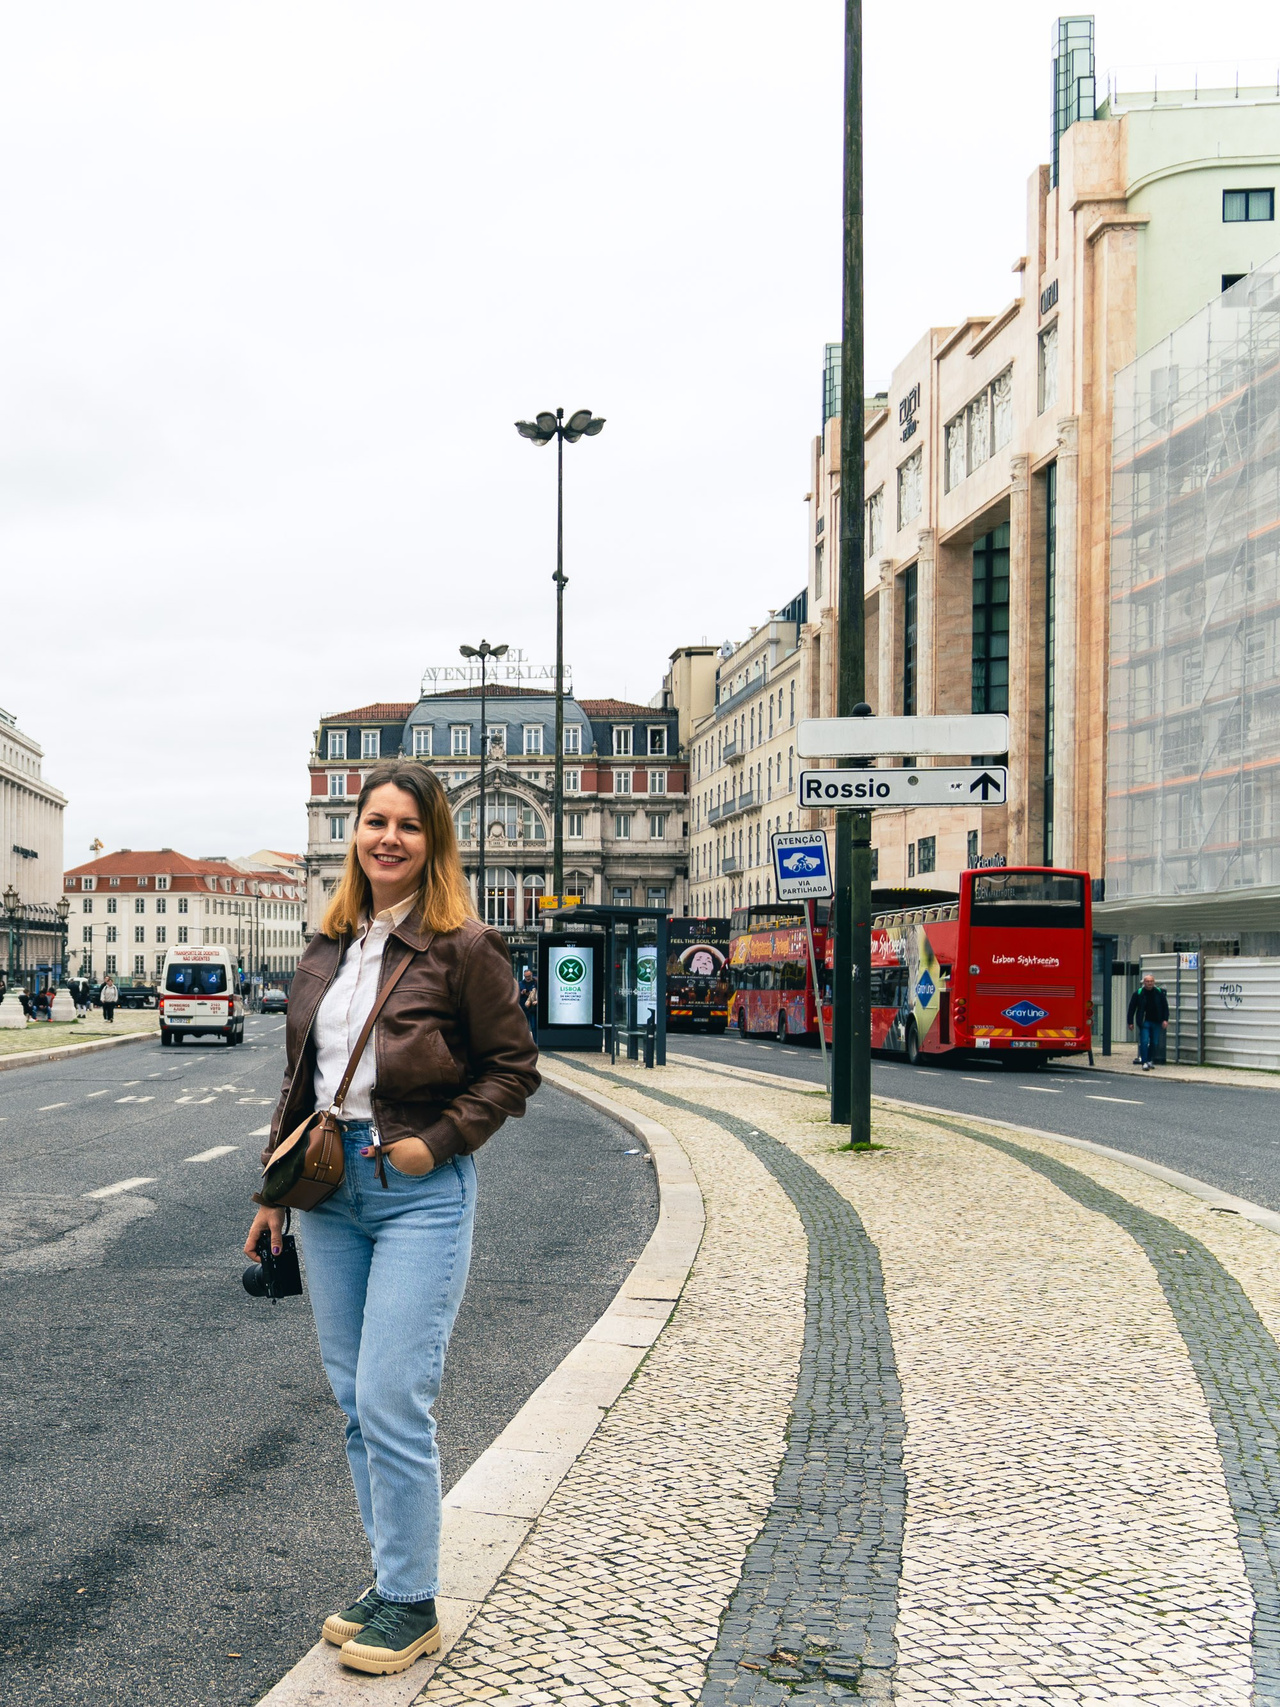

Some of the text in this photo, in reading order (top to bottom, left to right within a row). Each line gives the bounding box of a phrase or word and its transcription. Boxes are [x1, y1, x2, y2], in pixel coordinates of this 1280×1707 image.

[899, 382, 920, 426] EDEN
[421, 666, 498, 681] AVENIDA
[805, 777, 891, 799] Rossio
[777, 834, 822, 846] ATENÇÃO
[782, 886, 828, 895] PARTILHADA
[991, 954, 1060, 967] Lisbon Sightseeing
[1027, 1008, 1046, 1017] Line
